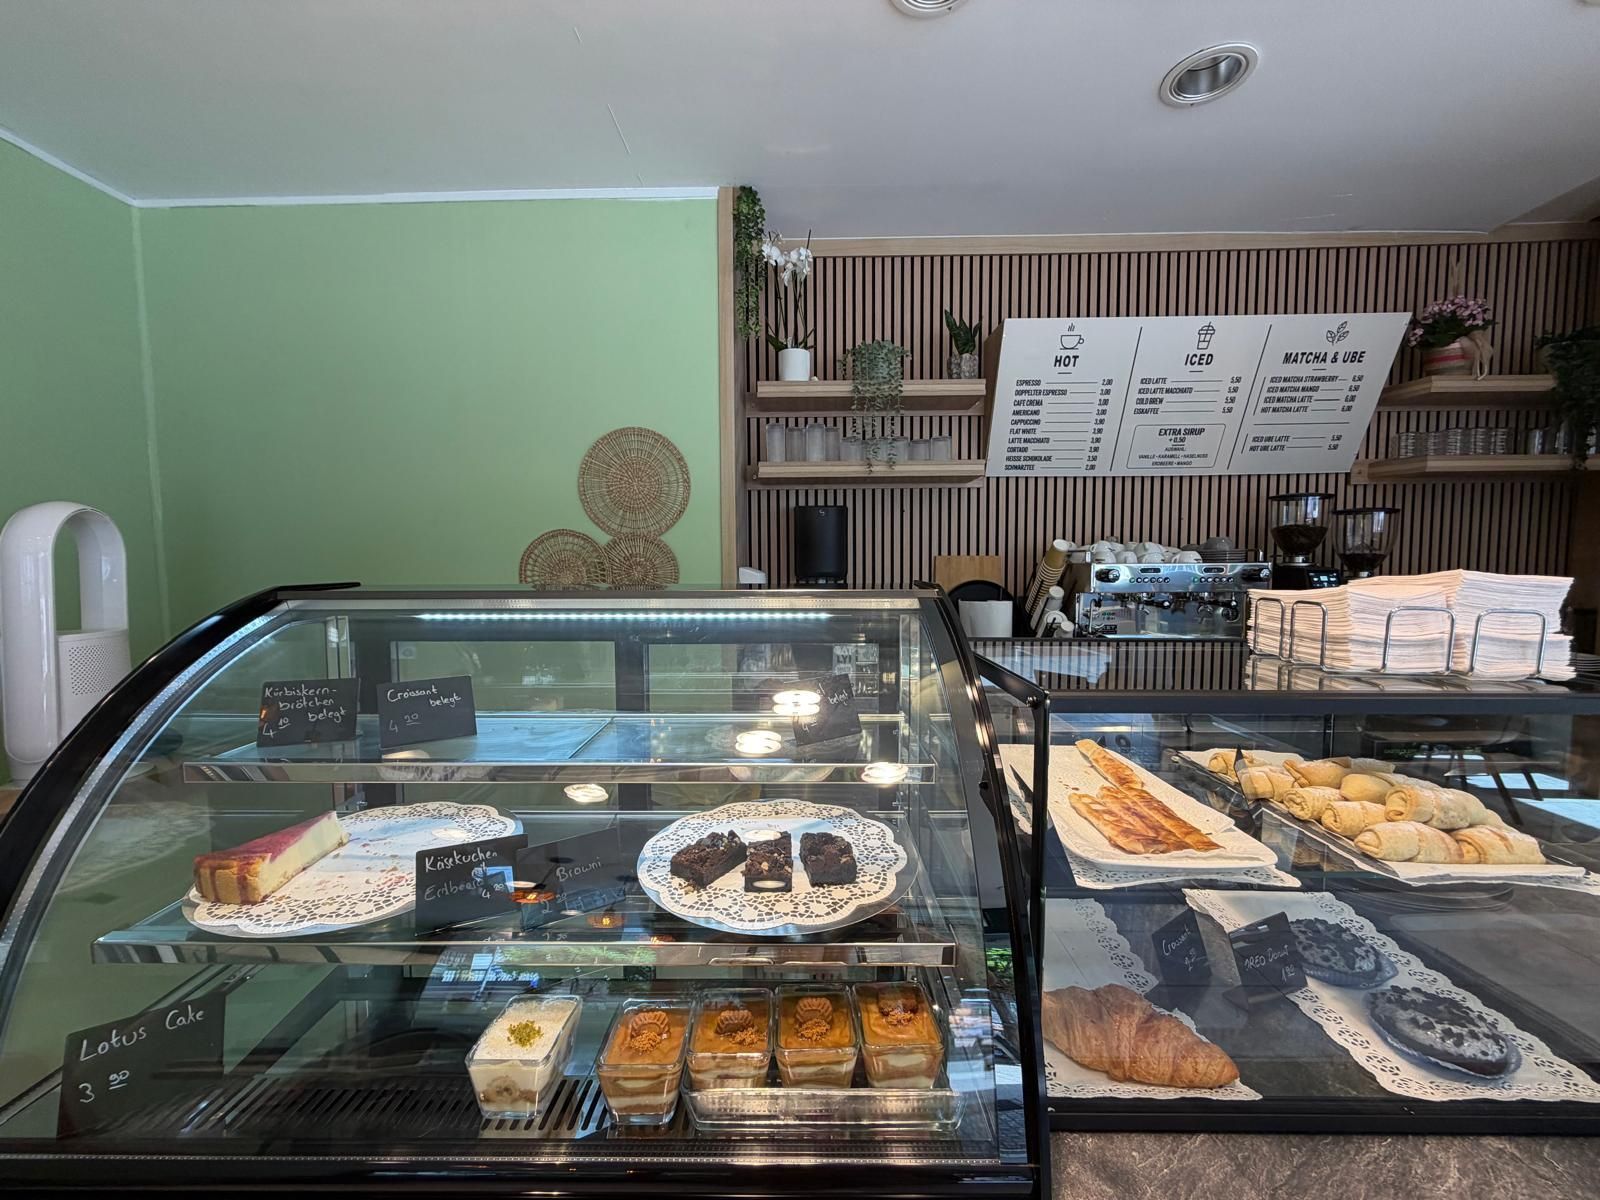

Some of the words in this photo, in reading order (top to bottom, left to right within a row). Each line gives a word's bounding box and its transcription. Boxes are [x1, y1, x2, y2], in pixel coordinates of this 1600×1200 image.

[1053, 355, 1080, 368] HOT
[1184, 353, 1214, 366] ICED
[1282, 351, 1328, 364] MATCHA
[1330, 351, 1339, 364] &
[1342, 350, 1366, 364] UBE
[1016, 379, 1042, 387] ESPRESSO
[1101, 378, 1114, 386] 2,00
[1152, 377, 1168, 385] LATTE
[1230, 376, 1242, 384] 5,50
[1282, 375, 1304, 383] MATCHA
[1014, 388, 1042, 396] DOPPELTER
[1042, 388, 1068, 396] ESPRESSO
[1137, 387, 1150, 395] ICED
[1149, 387, 1165, 395] LATTE
[1165, 386, 1193, 394] MACCHIATO
[1300, 385, 1320, 393] MANGO
[1135, 397, 1149, 405] COLD
[1149, 397, 1165, 405] BREW
[1224, 396, 1237, 404] 5,50
[1297, 395, 1314, 403] LATTE
[1133, 407, 1160, 415] EISKAFFEE
[1221, 406, 1233, 414] 5,50
[1292, 405, 1310, 413] LATTE
[1158, 428, 1182, 436] EXTRA
[1182, 427, 1206, 436] SIRUP
[1269, 444, 1286, 452] LATTE
[387, 684, 440, 702] Croissant
[278, 696, 335, 711] brötchen
[429, 692, 462, 709] belegt
[307, 706, 347, 723] belegt
[388, 718, 399, 733] 4
[424, 846, 499, 873] Käsekuchen
[481, 888, 491, 900] 4
[79, 1025, 148, 1062] Lotus
[165, 1004, 205, 1030] Cake
[78, 1083, 96, 1103] 3
[108, 1069, 130, 1090] 90
